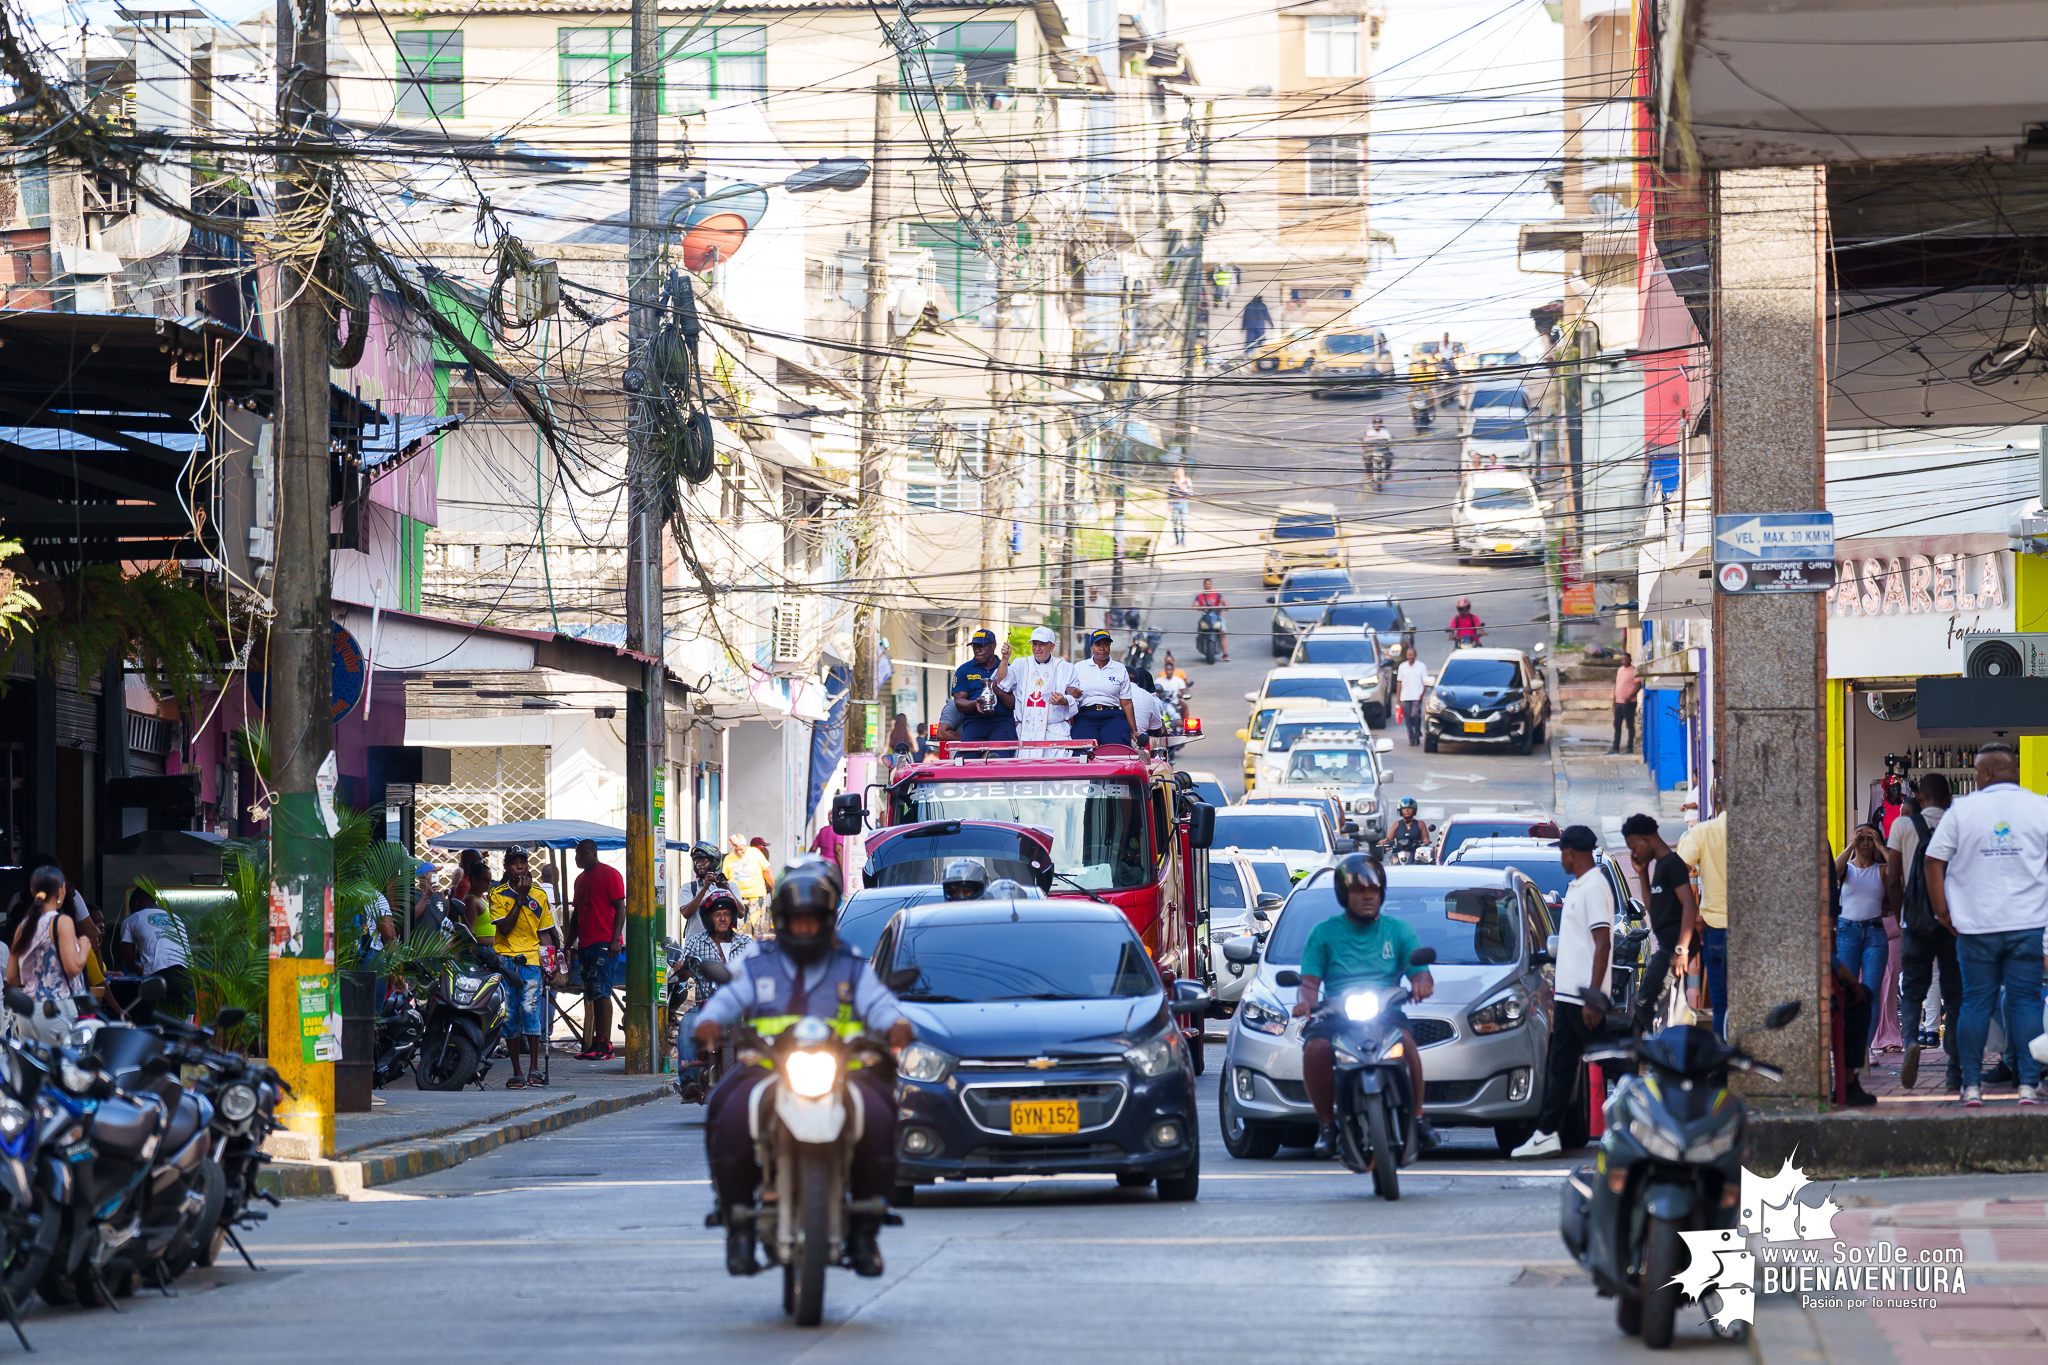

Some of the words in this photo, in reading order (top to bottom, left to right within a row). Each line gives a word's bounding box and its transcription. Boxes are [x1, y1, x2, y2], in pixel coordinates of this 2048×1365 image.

[1763, 532, 1788, 544] MAX.
[1790, 531, 1802, 542] 30
[1805, 530, 1830, 542] KM/H
[304, 1016, 323, 1026] JAIRO
